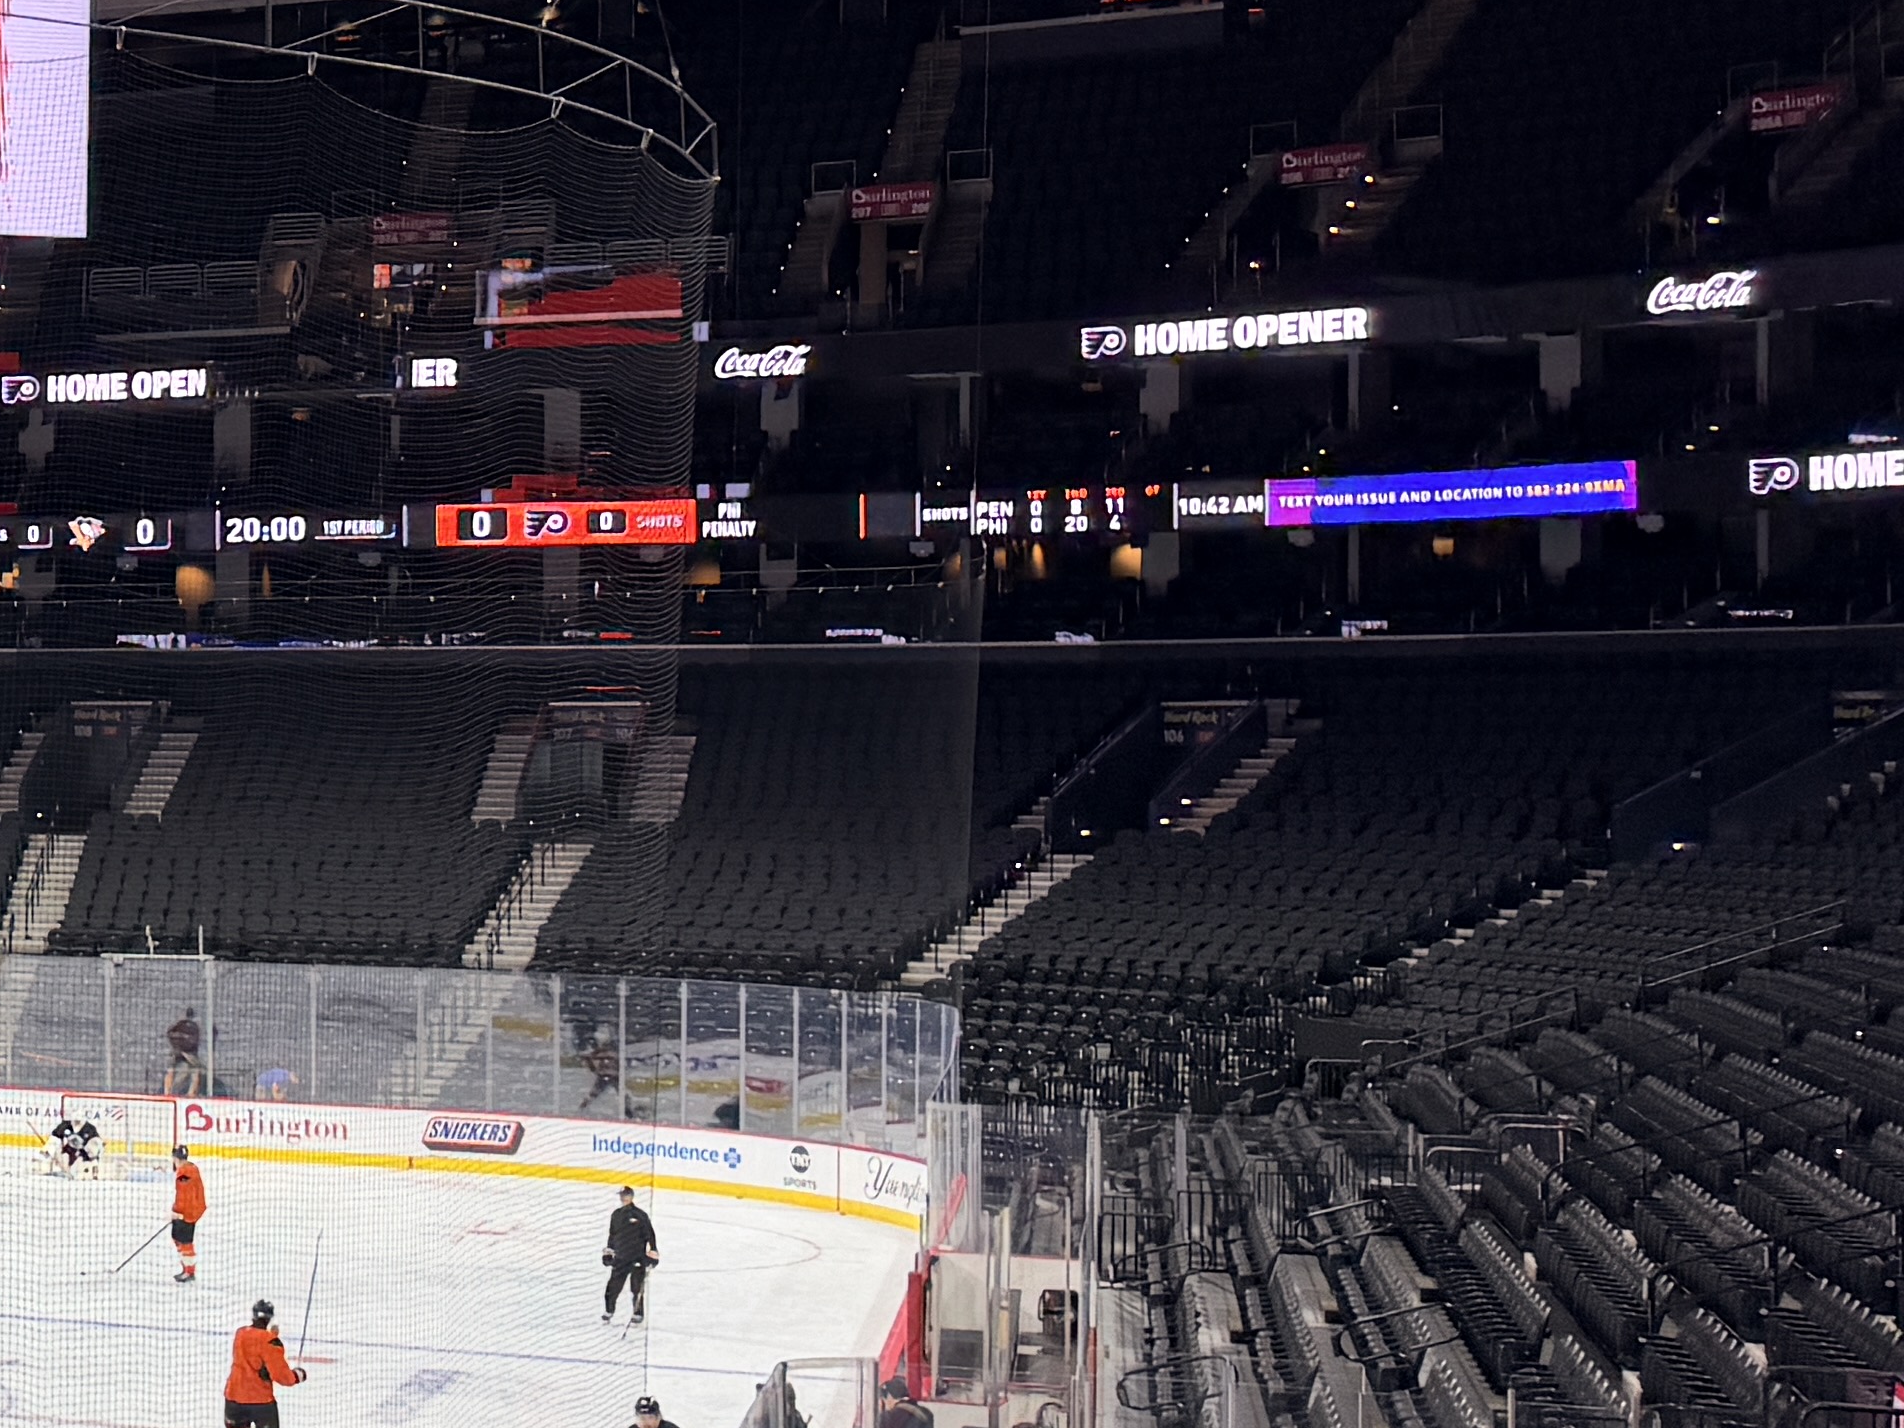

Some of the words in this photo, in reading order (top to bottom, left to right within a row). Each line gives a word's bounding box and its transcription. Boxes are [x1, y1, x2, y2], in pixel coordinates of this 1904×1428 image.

[852, 185, 931, 205] Burlington
[1646, 269, 1759, 315] Coca-Cola
[1134, 317, 1228, 356] HOME
[1232, 306, 1368, 349] OPENER
[714, 344, 811, 379] Coca-Cola
[46, 372, 128, 403] HOME
[1808, 449, 1904, 492] HOME
[1177, 496, 1230, 515] 10:42
[1232, 493, 1264, 513] AM
[1278, 494, 1312, 508] TEXT
[1314, 493, 1354, 507] YOUR
[1356, 491, 1396, 506] ISSUE
[1399, 490, 1432, 504] AND
[1434, 486, 1503, 502] LOCATION
[1505, 485, 1523, 498] TO
[922, 506, 968, 522] SHOTS
[976, 500, 1014, 518] PEN
[1030, 499, 1042, 516] 0
[27, 525, 39, 544] 0
[136, 520, 154, 544] 0
[225, 517, 306, 543] 20:00
[471, 511, 491, 538] 0
[702, 518, 756, 538] PENALTY
[976, 517, 1008, 536] PHI
[1030, 517, 1042, 533] 0
[1064, 515, 1088, 533] 20
[26, 1105, 40, 1117] OF
[185, 1103, 348, 1145] Burlington
[428, 1120, 512, 1143] SNICKERS
[592, 1133, 720, 1163] Independence
